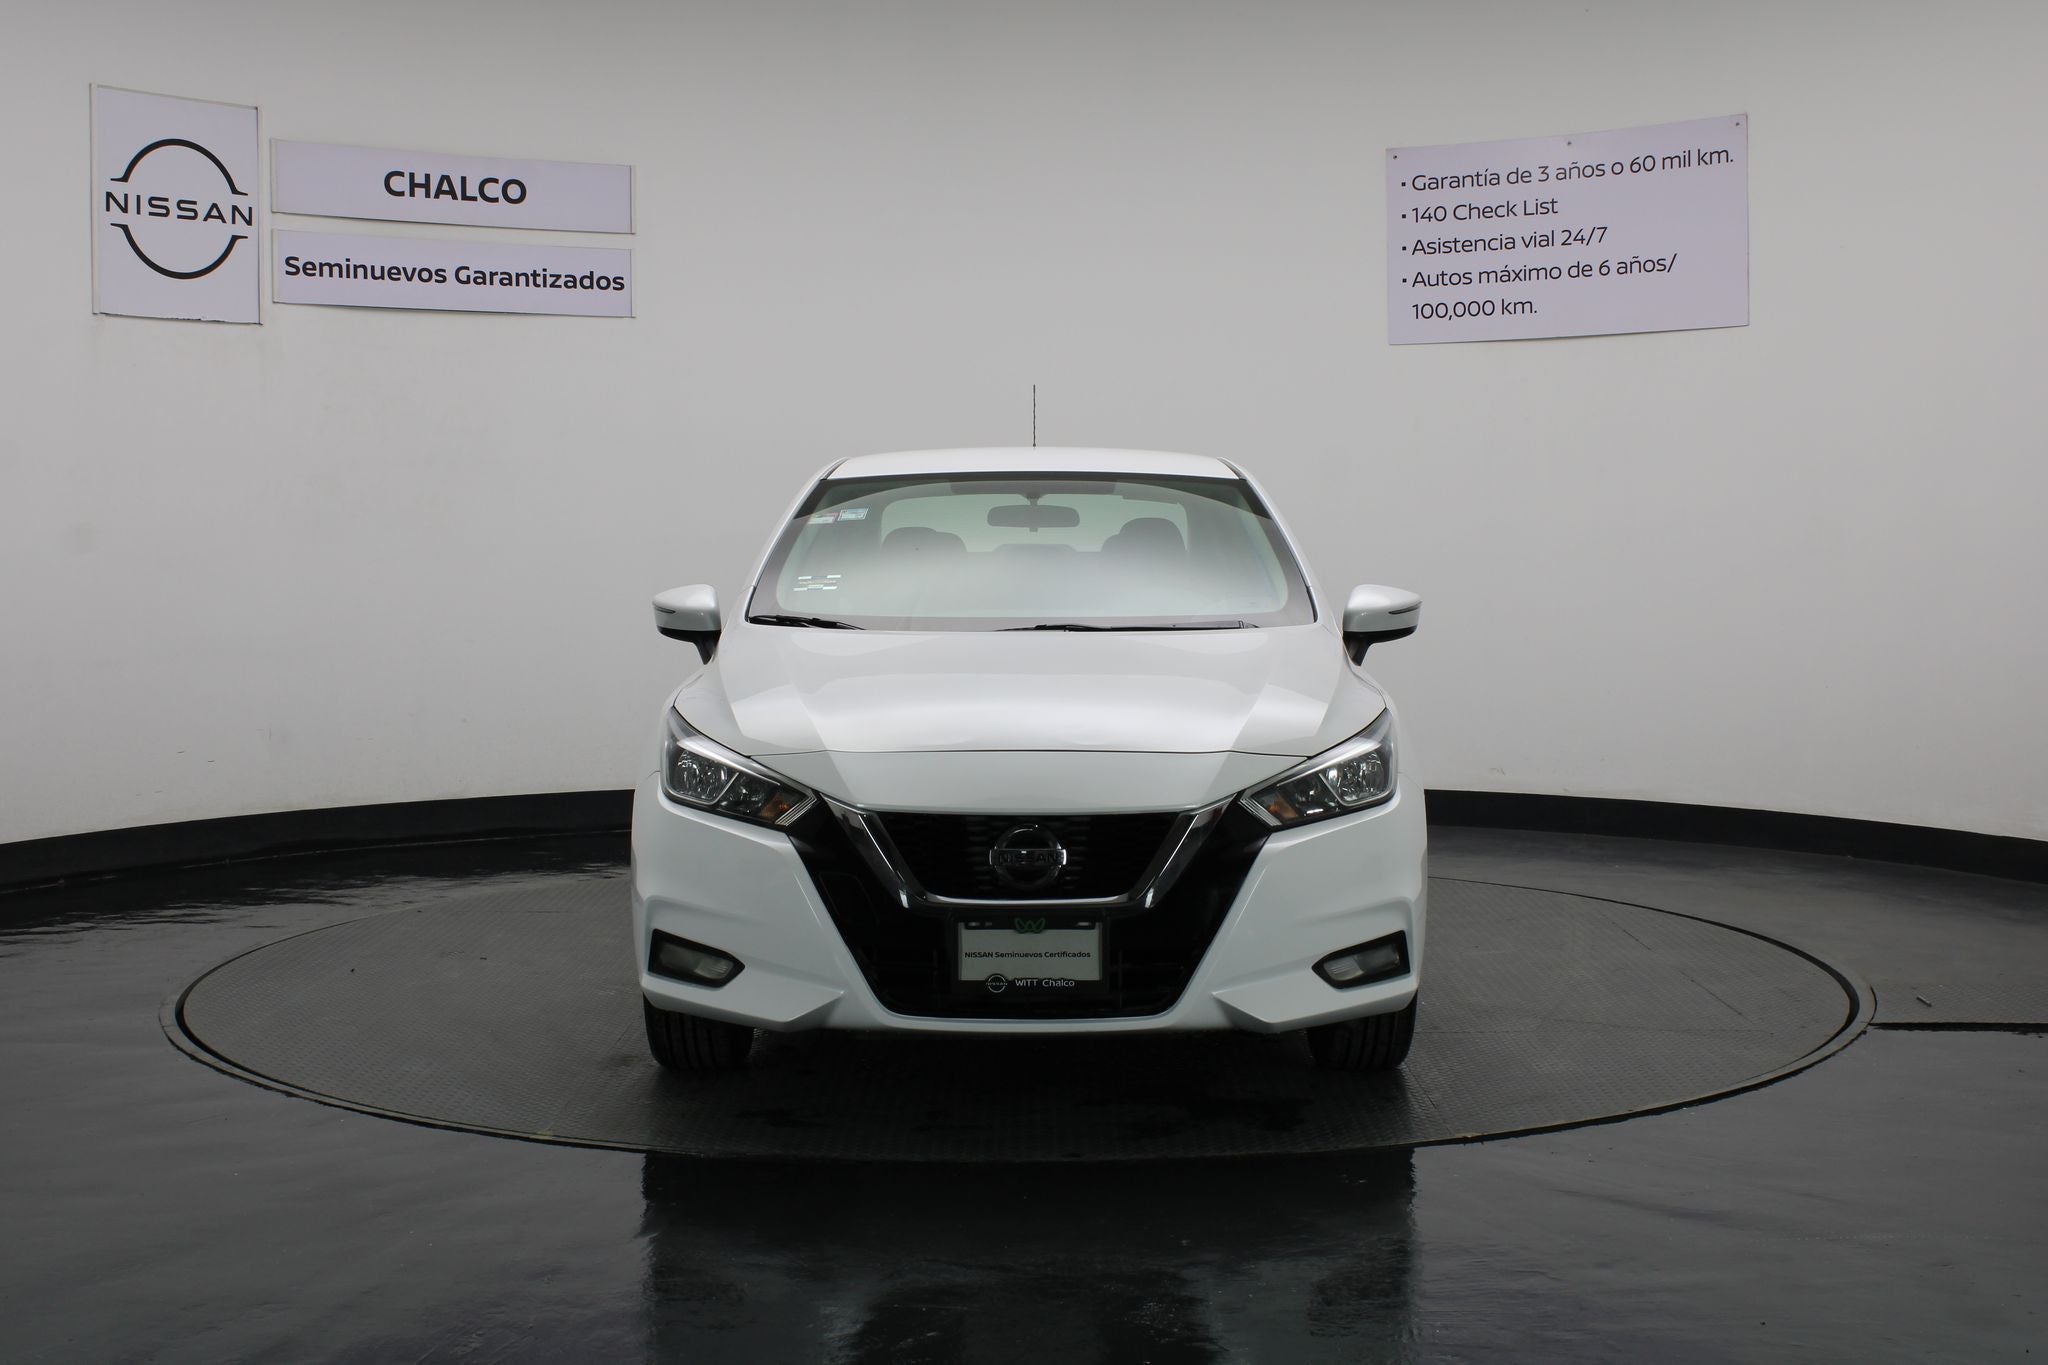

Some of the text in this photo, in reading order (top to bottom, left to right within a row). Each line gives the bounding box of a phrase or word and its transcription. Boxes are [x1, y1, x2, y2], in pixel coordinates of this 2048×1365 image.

[1412, 149, 1733, 191] Garantía de 3 años o 60 mil km.
[384, 171, 526, 204] CHALCO
[105, 191, 253, 226] NISSAN
[1412, 198, 1558, 223] 140 Check List
[1412, 227, 1607, 255] Asistencia vial 24/7
[285, 256, 624, 291] Seminuevos Garantizados
[1412, 253, 1677, 287] Autos máximo de 6 años/
[1412, 299, 1537, 320] 100,000 km.
[1042, 979, 1075, 988] Chalco
